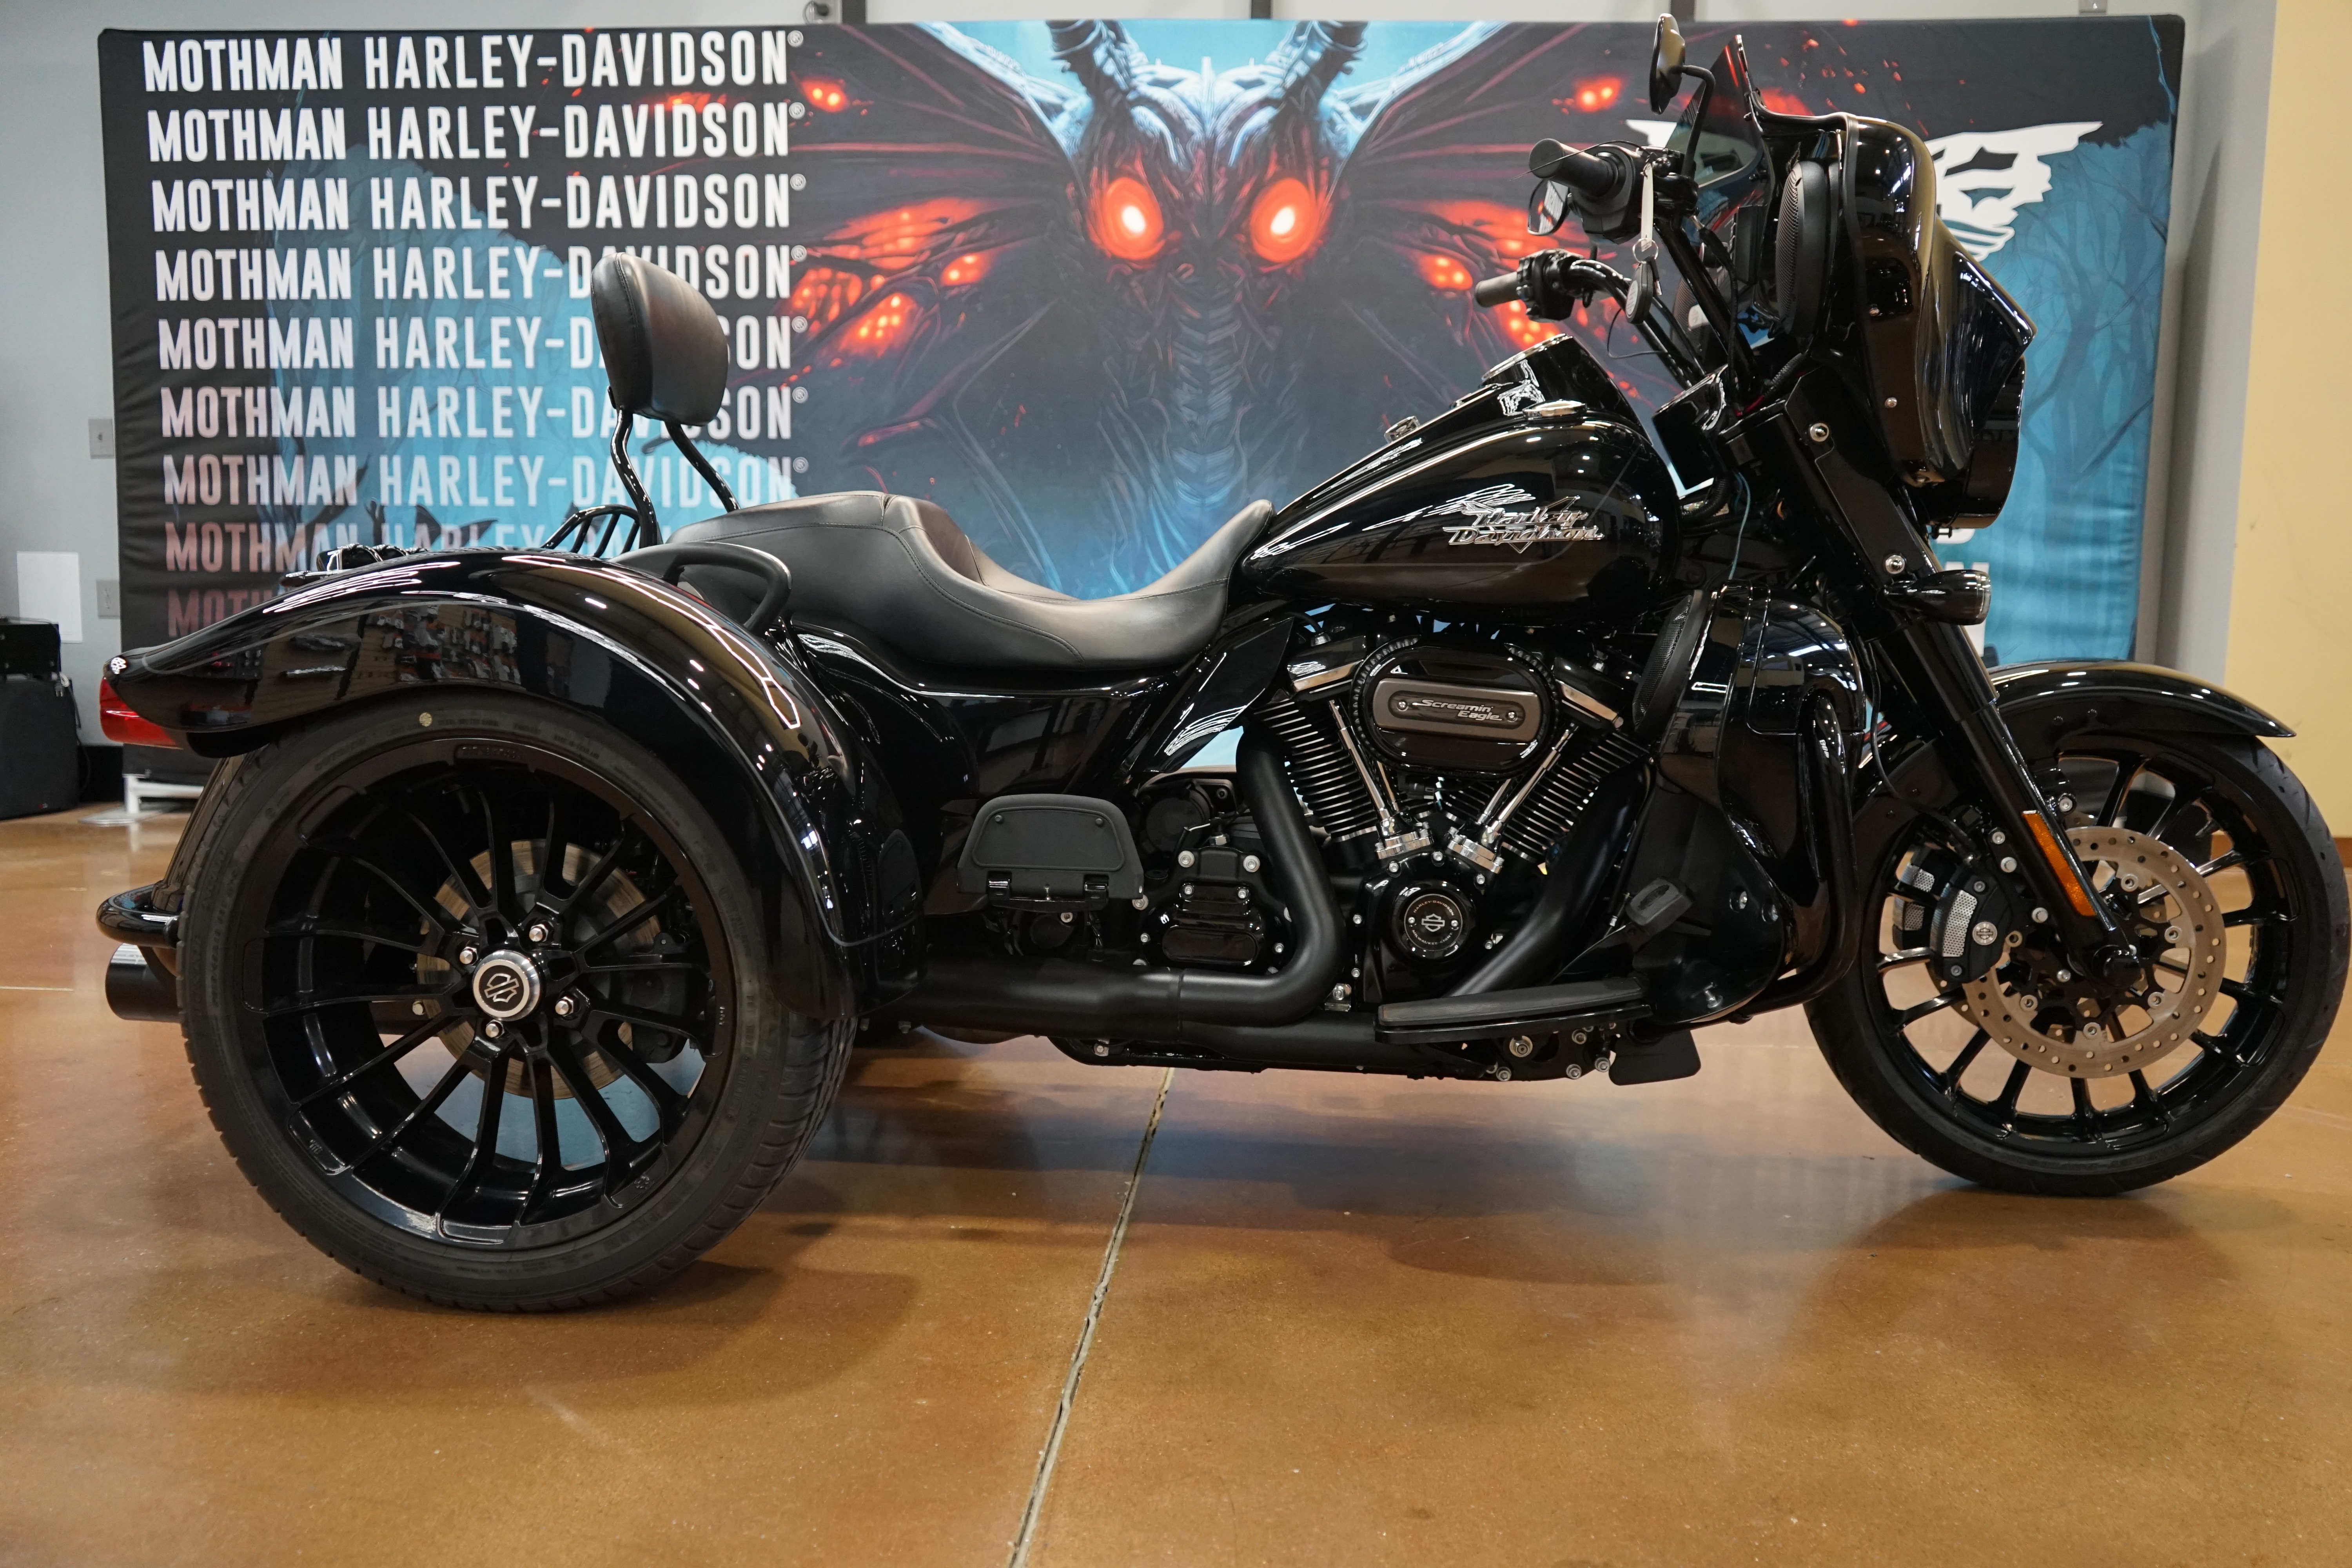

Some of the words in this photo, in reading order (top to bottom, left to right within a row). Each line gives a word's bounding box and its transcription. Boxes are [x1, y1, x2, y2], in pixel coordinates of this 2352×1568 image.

[143, 38, 343, 92] MOTHMAN
[148, 108, 346, 162] MOTHMAN
[152, 178, 349, 232] MOTHMAN
[156, 248, 352, 301] MOTHMAN
[159, 318, 354, 370] MOTHMAN
[161, 386, 356, 438] MOTHMAN
[163, 454, 359, 506] MOTHMAN
[1457, 710, 1503, 721] Eagle
